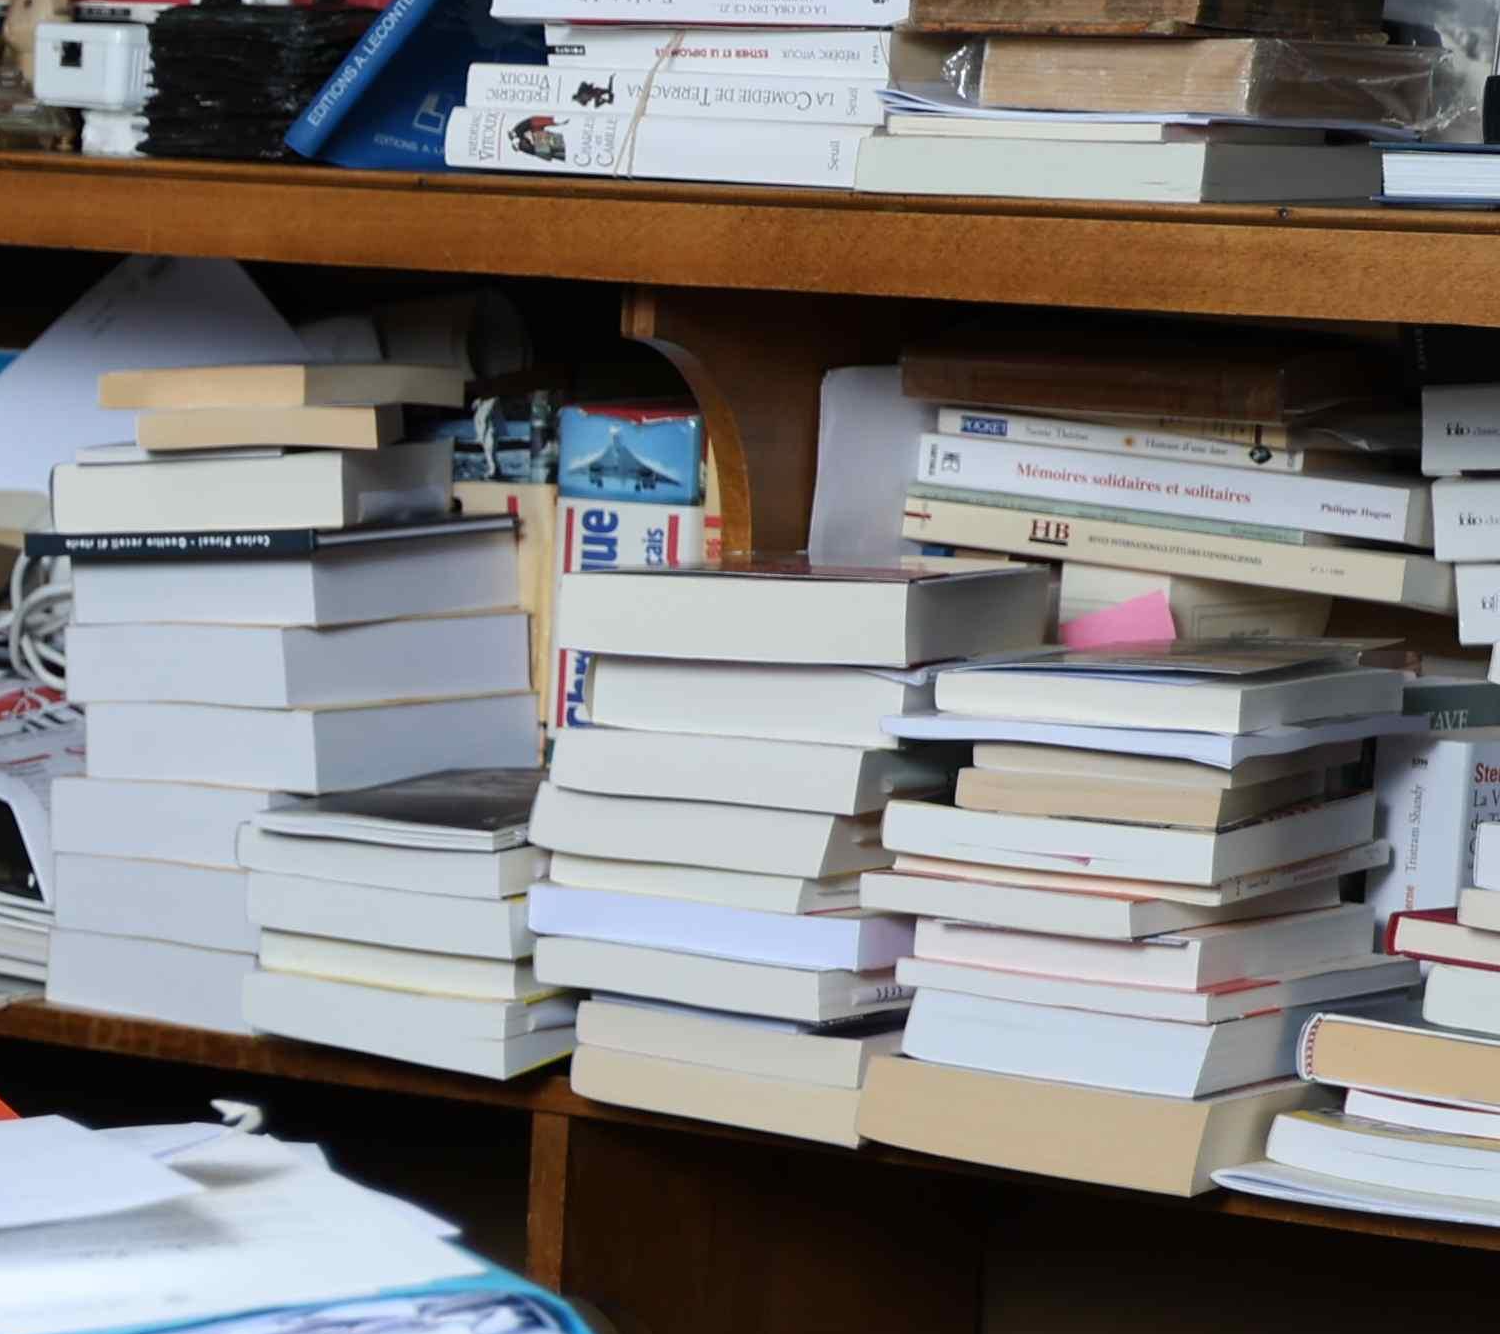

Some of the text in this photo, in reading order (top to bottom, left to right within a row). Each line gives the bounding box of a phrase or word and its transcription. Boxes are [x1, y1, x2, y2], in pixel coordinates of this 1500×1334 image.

[735, 48, 770, 60] ESTHER
[500, 71, 551, 90] VITOUX
[305, 63, 362, 128] EDITIONS
[485, 88, 551, 103] FRÉDÉRIC
[713, 87, 736, 103] DE
[812, 89, 835, 106] LA
[827, 140, 842, 170] Seuil
[1016, 461, 1253, 505] Mémoires solidaires et solitaires
[1320, 501, 1357, 520] Philippe
[1028, 518, 1072, 542] HB
[1473, 788, 1488, 808] La
